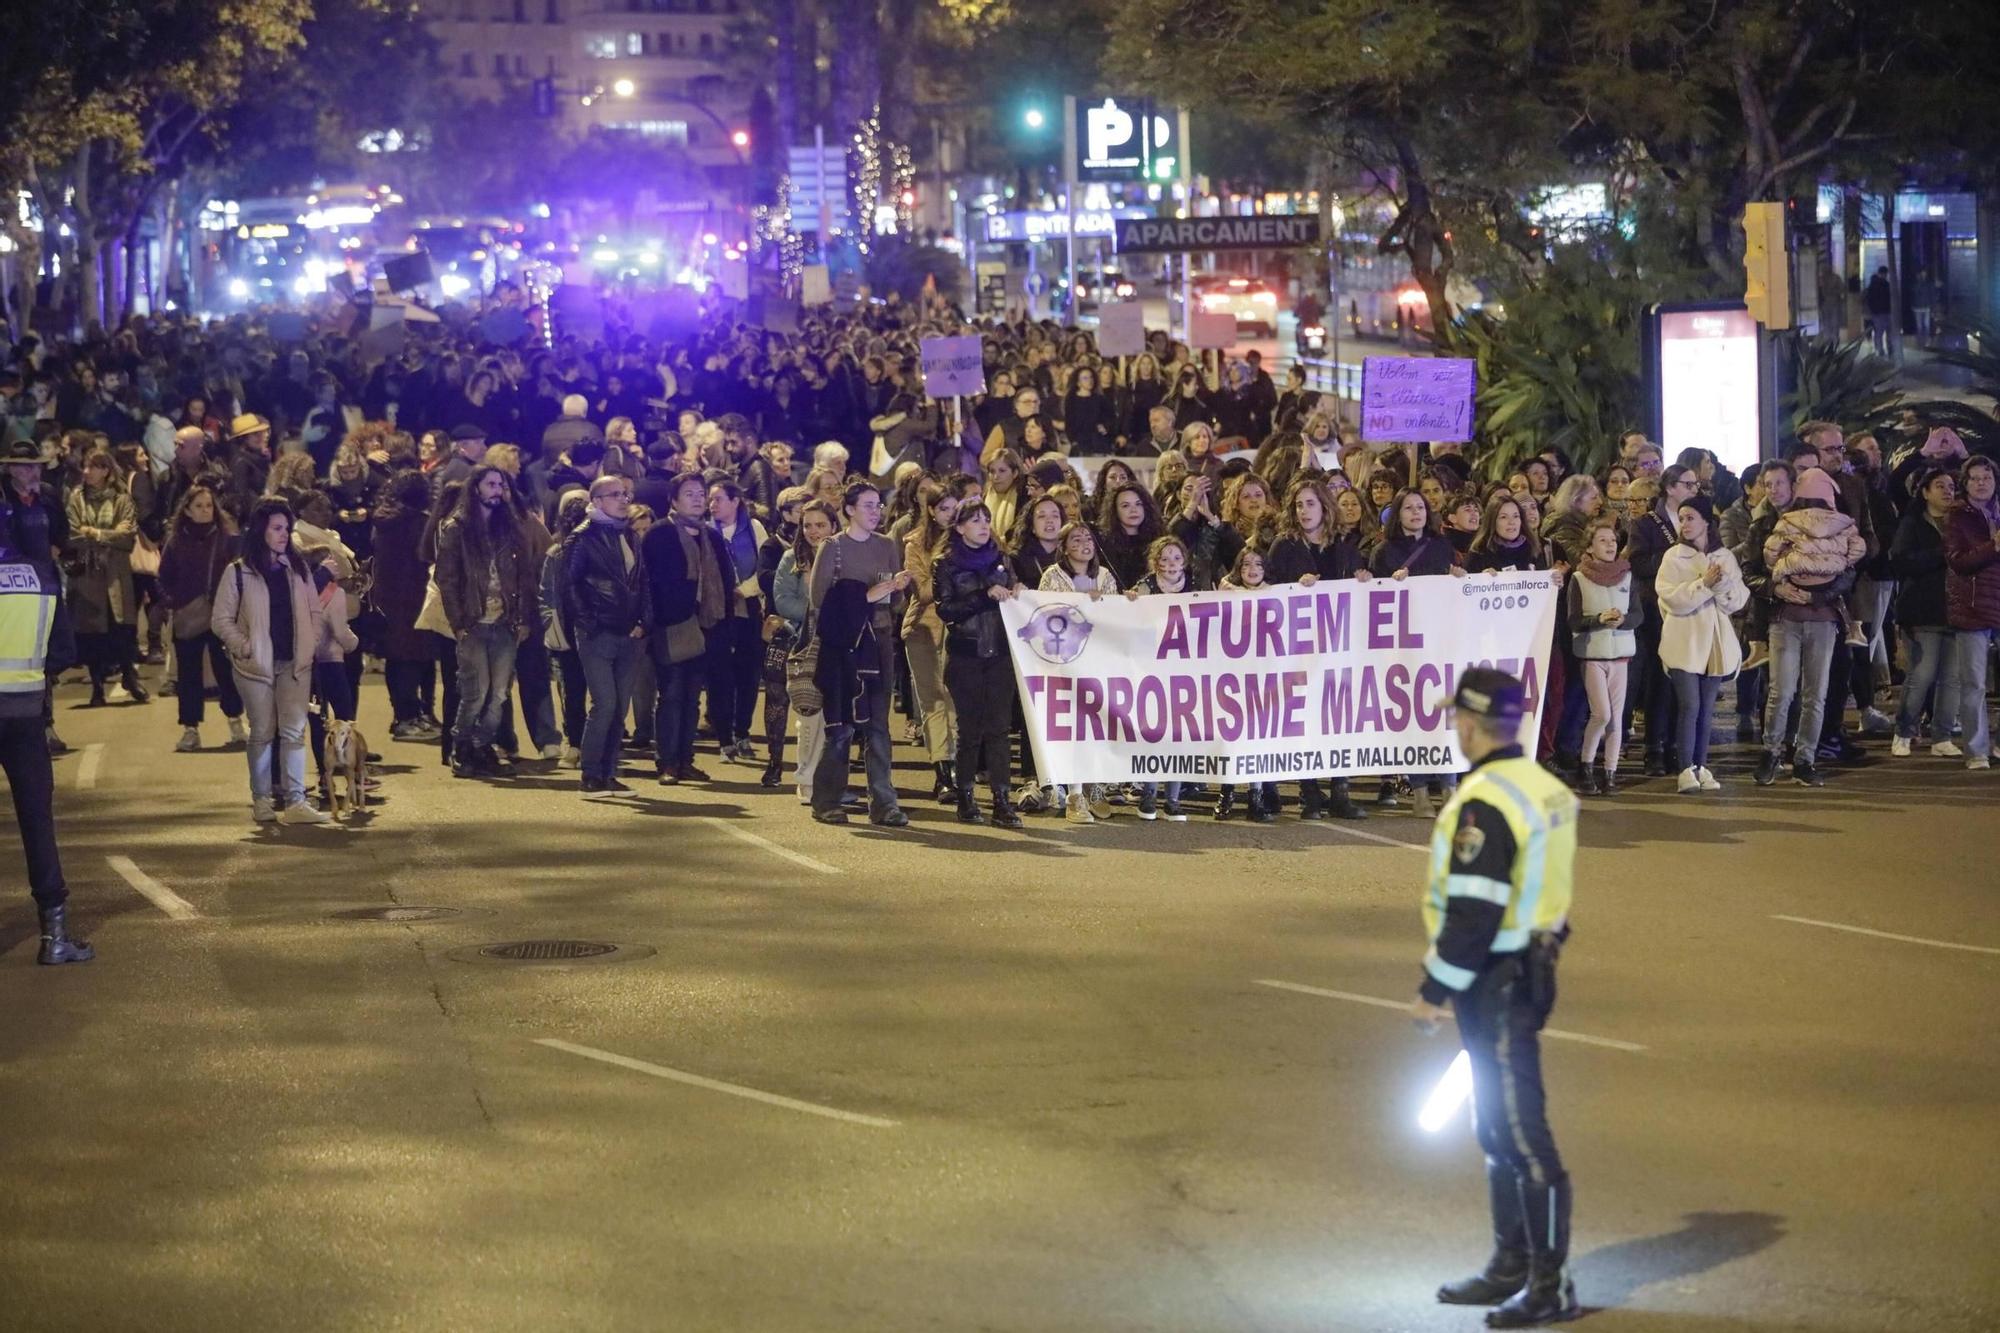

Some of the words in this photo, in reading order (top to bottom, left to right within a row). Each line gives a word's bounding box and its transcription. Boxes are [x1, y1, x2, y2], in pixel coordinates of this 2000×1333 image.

[1124, 219, 1312, 246] APARCAMENT
[1369, 415, 1393, 431] NO
[1156, 592, 1351, 660] ATUREM
[1368, 590, 1424, 650] EL
[1024, 670, 1308, 744] TERRORISME
[1131, 754, 1231, 776] MOVIMENT
[1235, 750, 1324, 775] FEMINISTA
[1329, 749, 1351, 768] DE
[1356, 745, 1453, 768] MALLORCA
